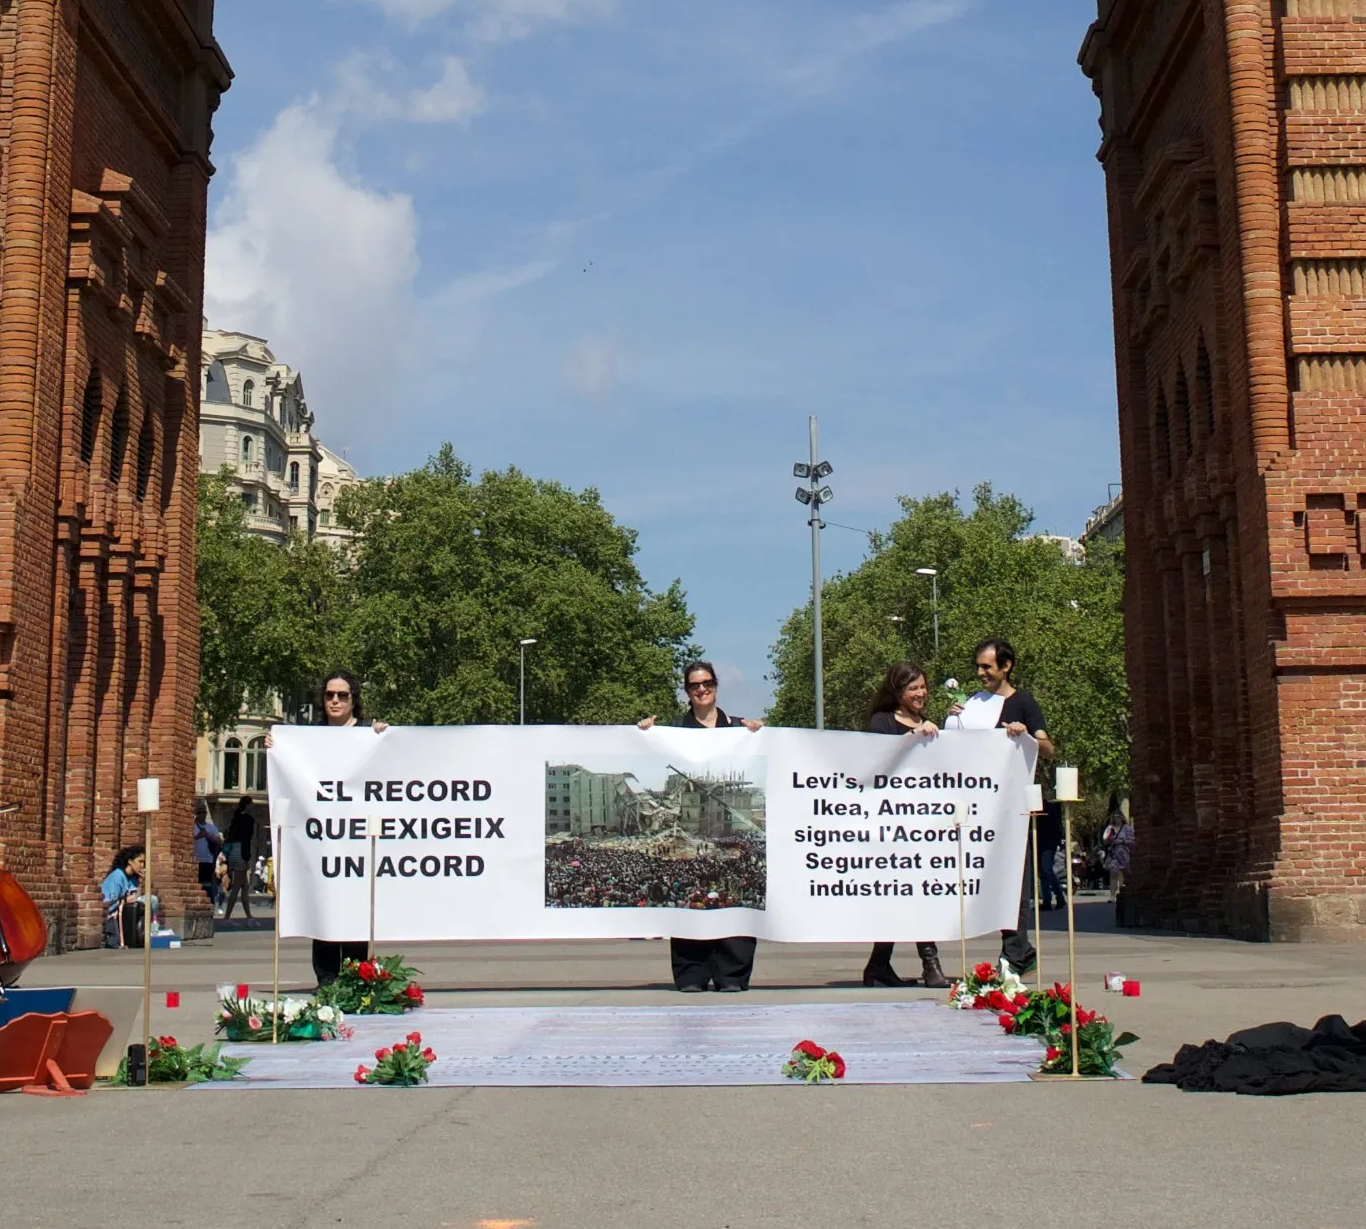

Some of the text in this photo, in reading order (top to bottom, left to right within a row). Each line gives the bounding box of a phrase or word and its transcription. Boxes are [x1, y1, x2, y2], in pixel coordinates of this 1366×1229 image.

[316, 779, 492, 802] EL RECORD
[792, 772, 999, 793] Levi's, Decathlon,
[813, 799, 978, 819] Ikea, Amazo:
[305, 817, 505, 841] QUE EXIGEIX
[794, 825, 996, 847] signeu l'Acord de
[321, 855, 485, 878] UN ACORD
[805, 852, 985, 874] Seguretat en la
[810, 879, 914, 897] indústria
